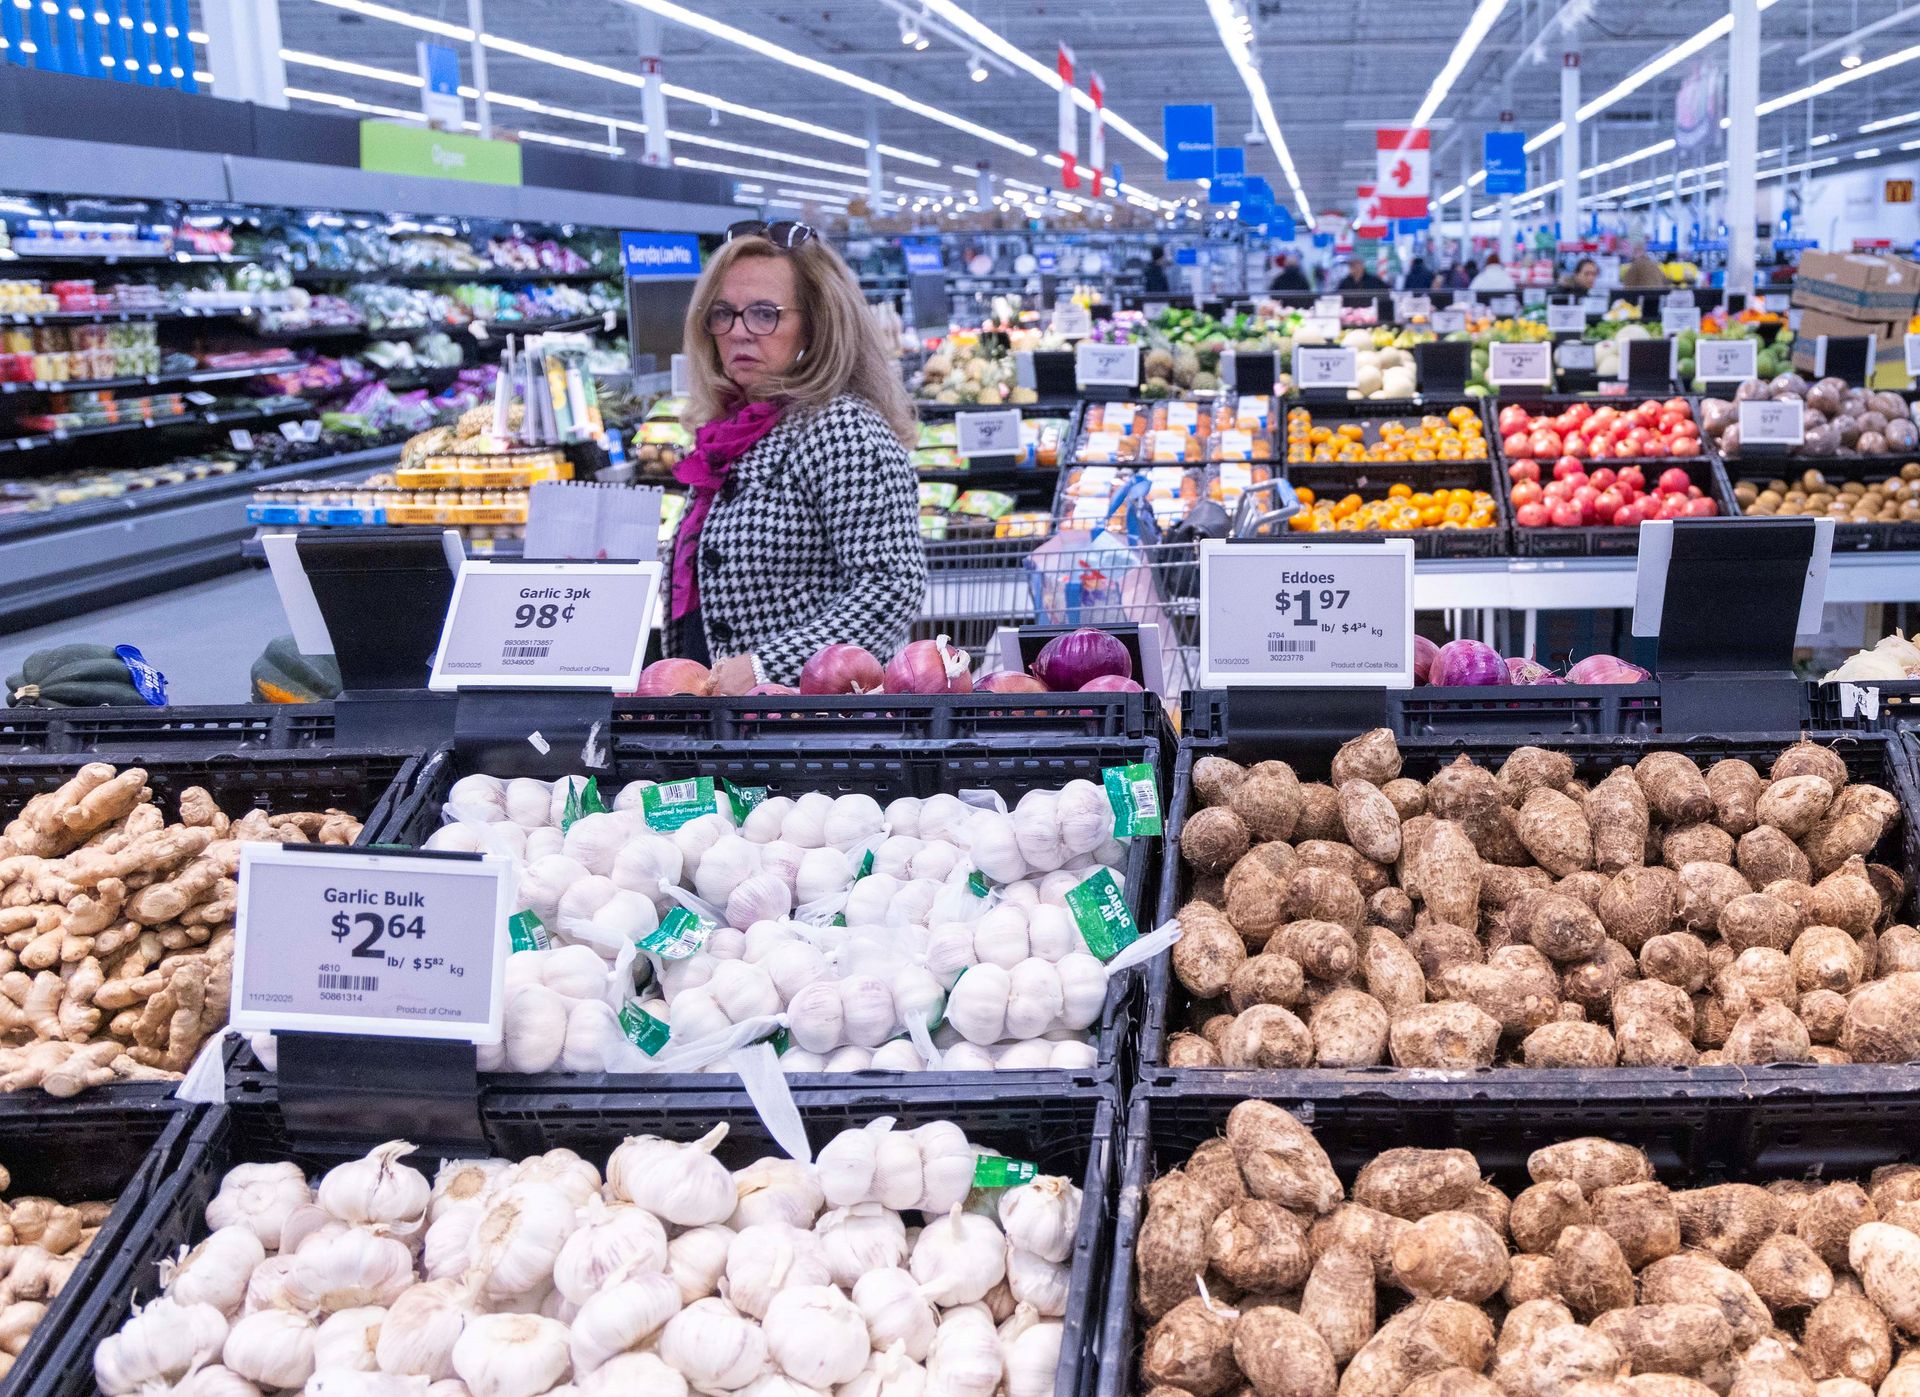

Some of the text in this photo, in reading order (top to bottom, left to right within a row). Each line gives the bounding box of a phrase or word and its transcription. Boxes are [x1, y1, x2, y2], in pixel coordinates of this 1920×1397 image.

[628, 244, 692, 267] Everyday Low Price
[1281, 571, 1335, 584] Eddoes
[519, 588, 591, 601] Garlic 3pk
[514, 603, 576, 629] 98¢
[1321, 623, 1336, 633] lb/
[1371, 627, 1383, 638] kg
[1270, 654, 1305, 662] 30223778
[1330, 661, 1399, 669] Product of Costa Rica
[323, 888, 425, 907] Garlic Bulk
[1104, 884, 1131, 928] GARLIC
[318, 963, 341, 973] 4610
[387, 956, 405, 969] lb/
[450, 964, 464, 977] kg
[249, 993, 294, 1003] 11/12/2025
[320, 992, 363, 1002] 50861314
[396, 1004, 462, 1017] Product of China
